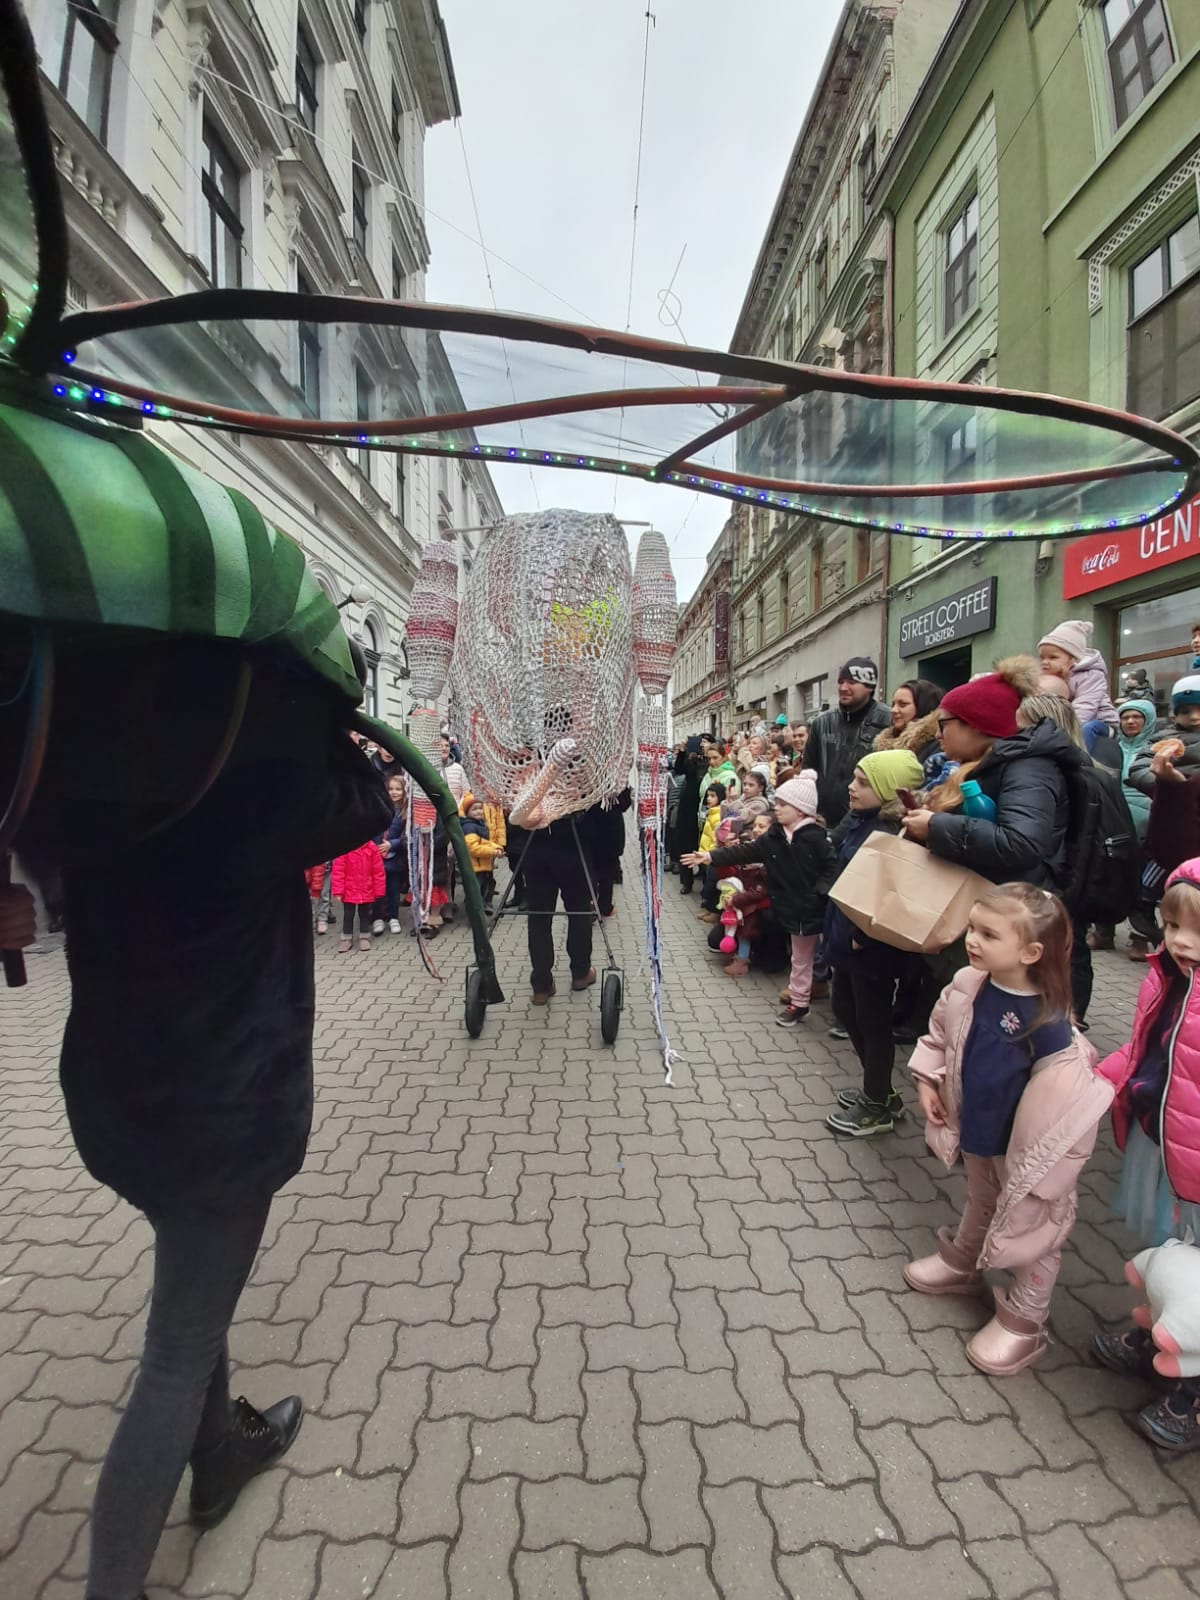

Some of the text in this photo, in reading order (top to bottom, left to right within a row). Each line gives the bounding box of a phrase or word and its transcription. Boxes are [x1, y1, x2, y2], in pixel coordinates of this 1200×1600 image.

[901, 586, 989, 642] STREET COFFEE
[924, 625, 955, 646] ROASTERS
